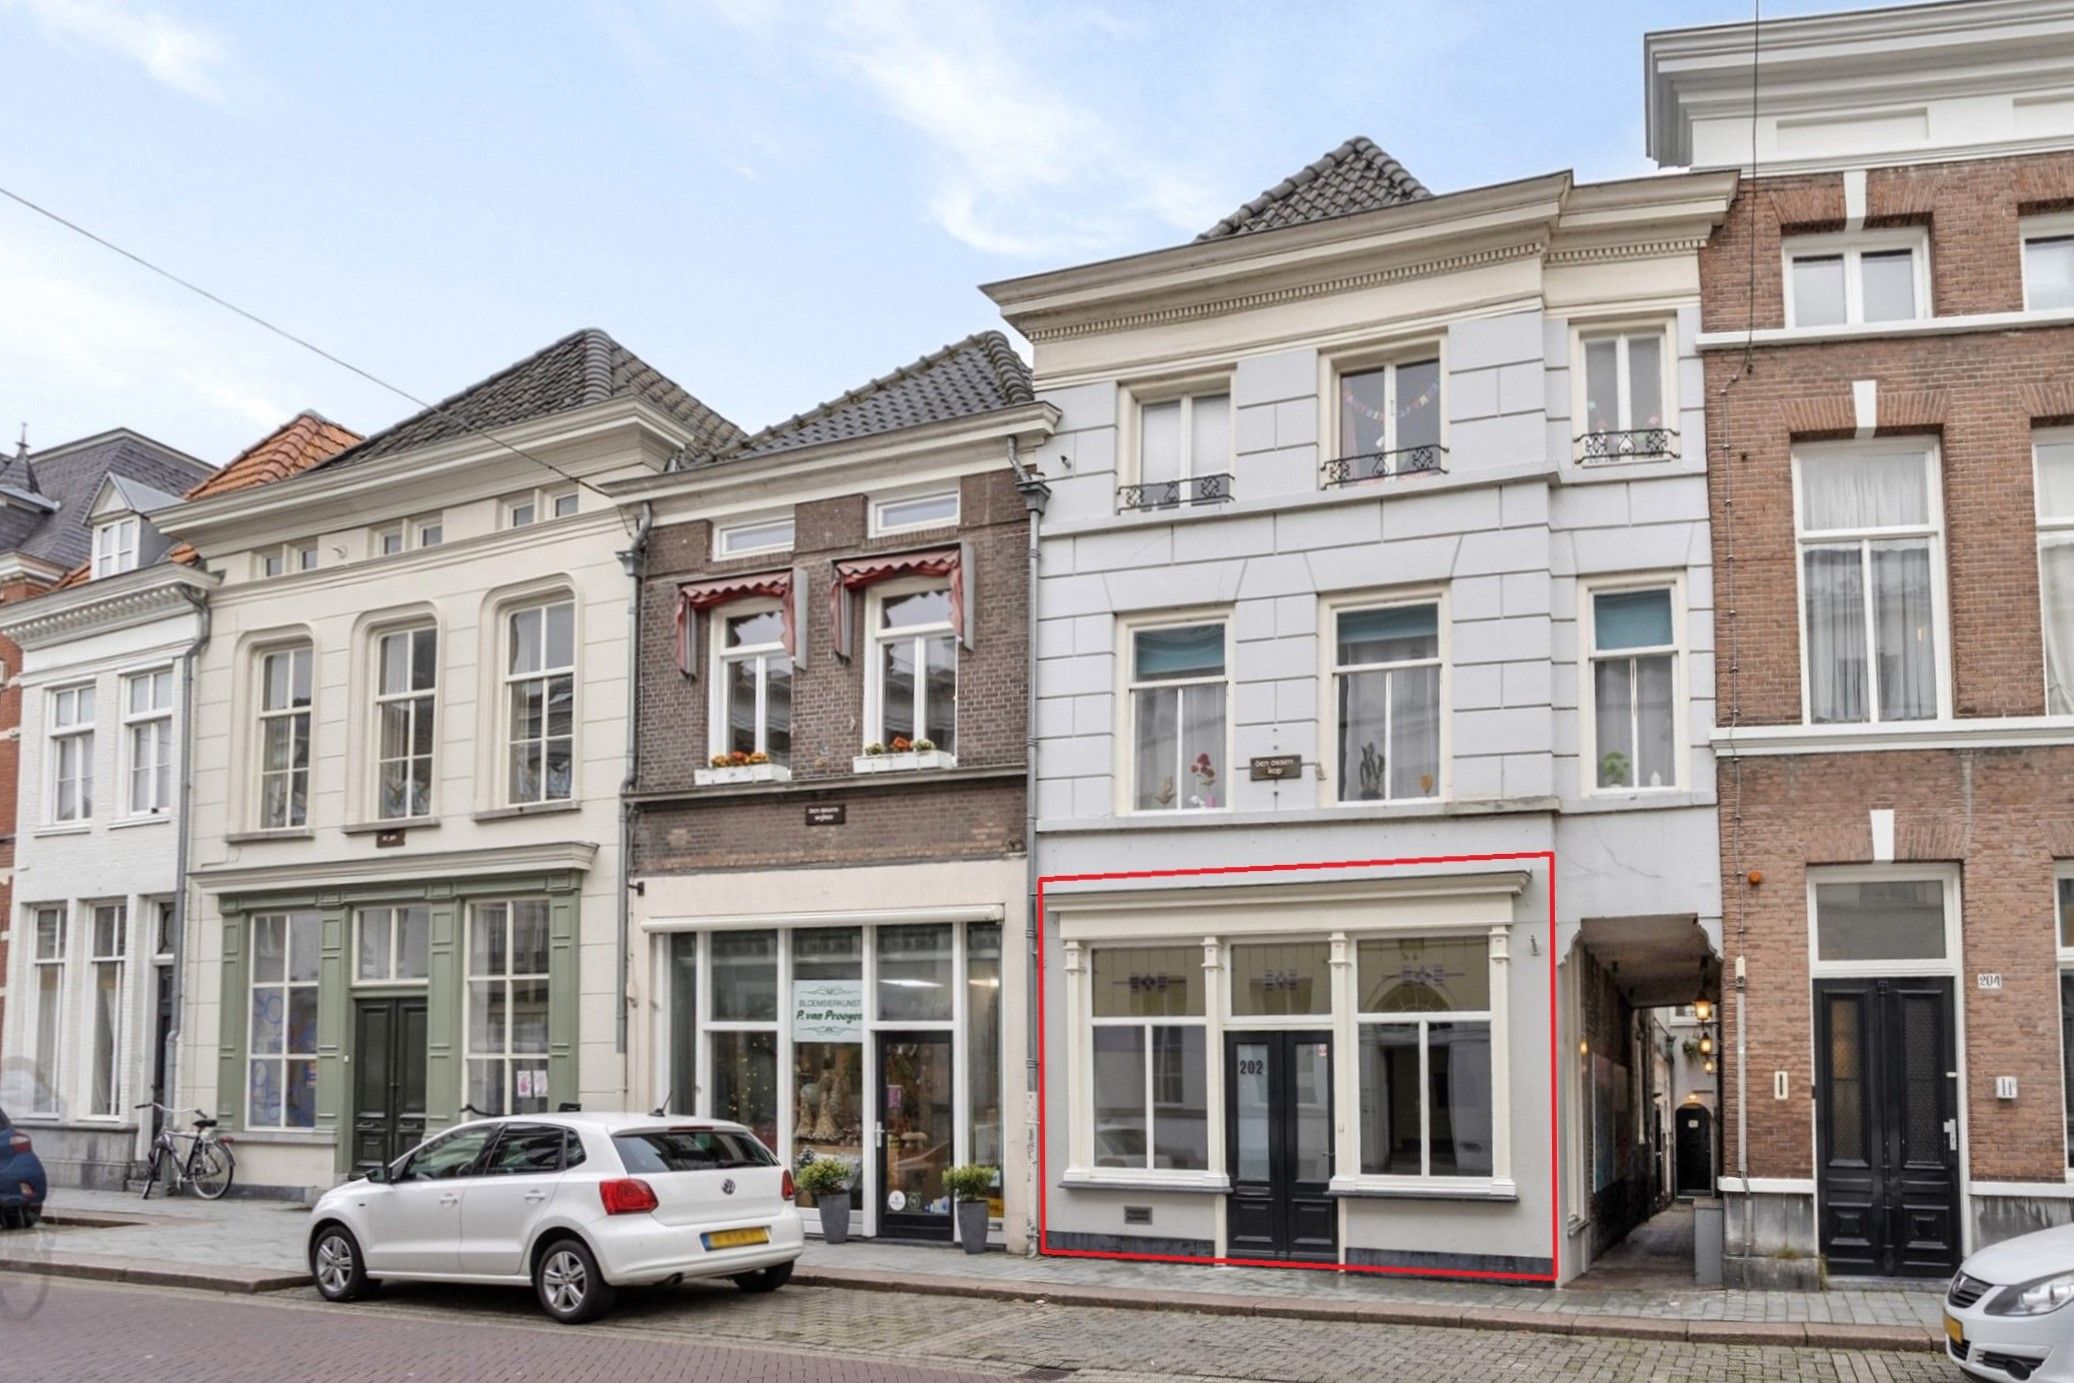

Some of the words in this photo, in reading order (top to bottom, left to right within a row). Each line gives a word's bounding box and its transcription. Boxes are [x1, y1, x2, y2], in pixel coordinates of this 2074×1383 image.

[796, 1009, 805, 1020] P.
[805, 1012, 823, 1020] van
[1239, 1060, 1263, 1075] 202
